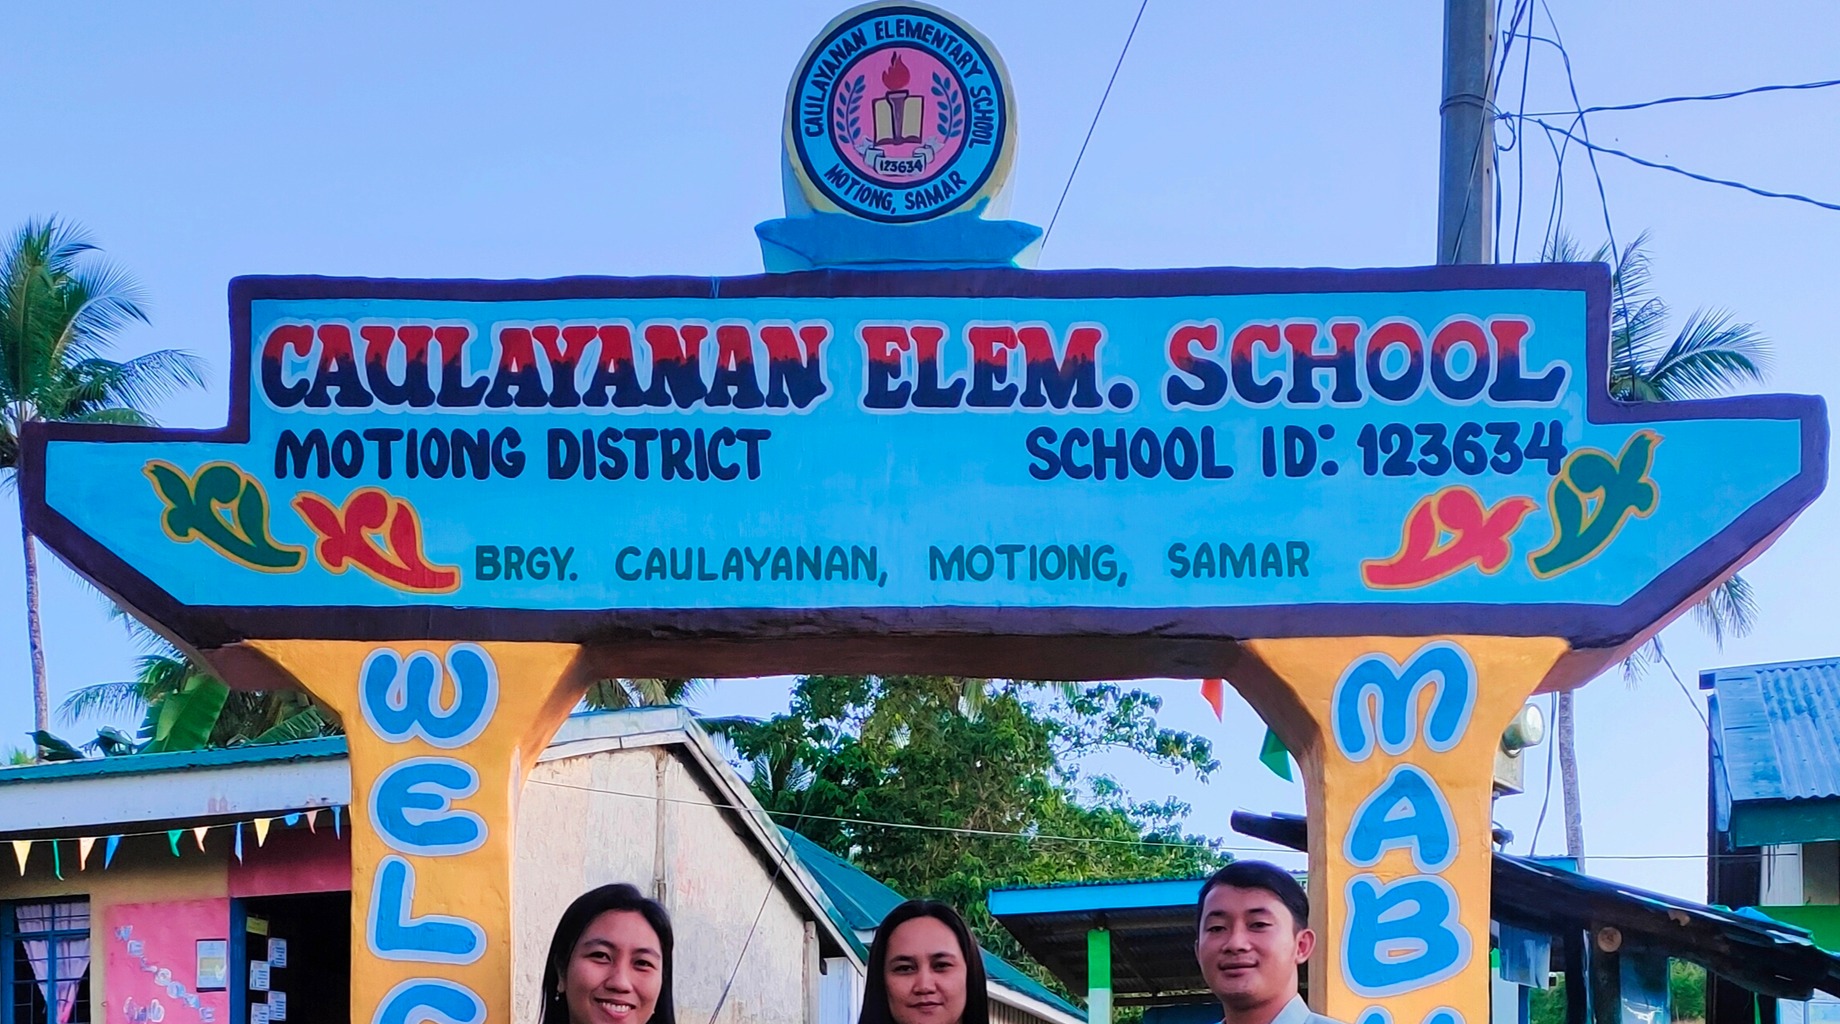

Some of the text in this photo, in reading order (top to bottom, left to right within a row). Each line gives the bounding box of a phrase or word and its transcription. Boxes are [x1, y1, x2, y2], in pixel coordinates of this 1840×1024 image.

[803, 18, 995, 149] CAULAYANAN ELEMENTARY SCHOOL
[823, 163, 968, 215] MOTIONG, SAMAR
[879, 158, 924, 174] 123634
[258, 319, 1568, 411] CAULAYANAN ELEM. SCHOOL
[274, 426, 772, 481] MOTIONG DISTRICT
[1026, 421, 1568, 480] SCHOOL ID: 123634
[475, 541, 1310, 588] BRGY. CAULAYANAN, MOTIONG, SAMAR
